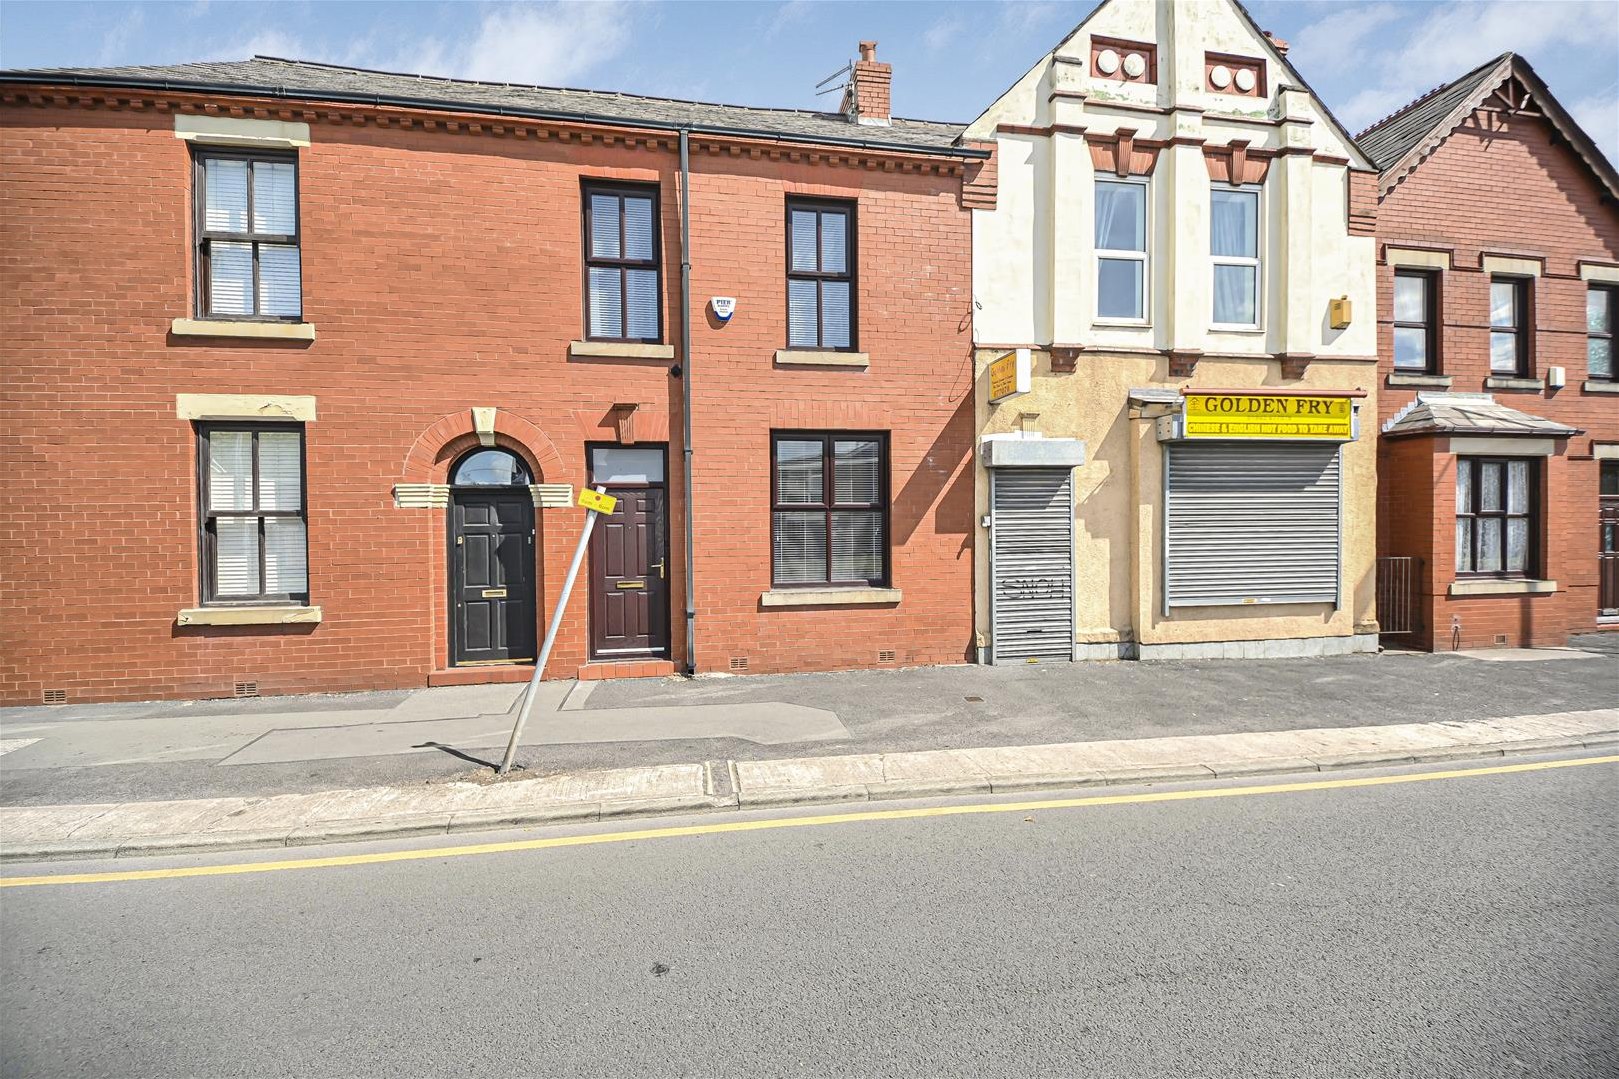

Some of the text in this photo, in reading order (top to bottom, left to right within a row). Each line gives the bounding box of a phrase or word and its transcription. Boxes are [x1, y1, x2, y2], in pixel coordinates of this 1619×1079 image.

[1205, 397, 1288, 413] GOLDEN
[1295, 399, 1334, 414] FRY
[1188, 423, 1220, 433] CHINESE
[1229, 424, 1260, 433] ENGLISH
[1261, 424, 1277, 433] HOT
[1277, 424, 1298, 434] FOOD
[1299, 425, 1309, 433] TO
[1310, 425, 1328, 434] TAKE
[1328, 425, 1348, 434] AWAY
